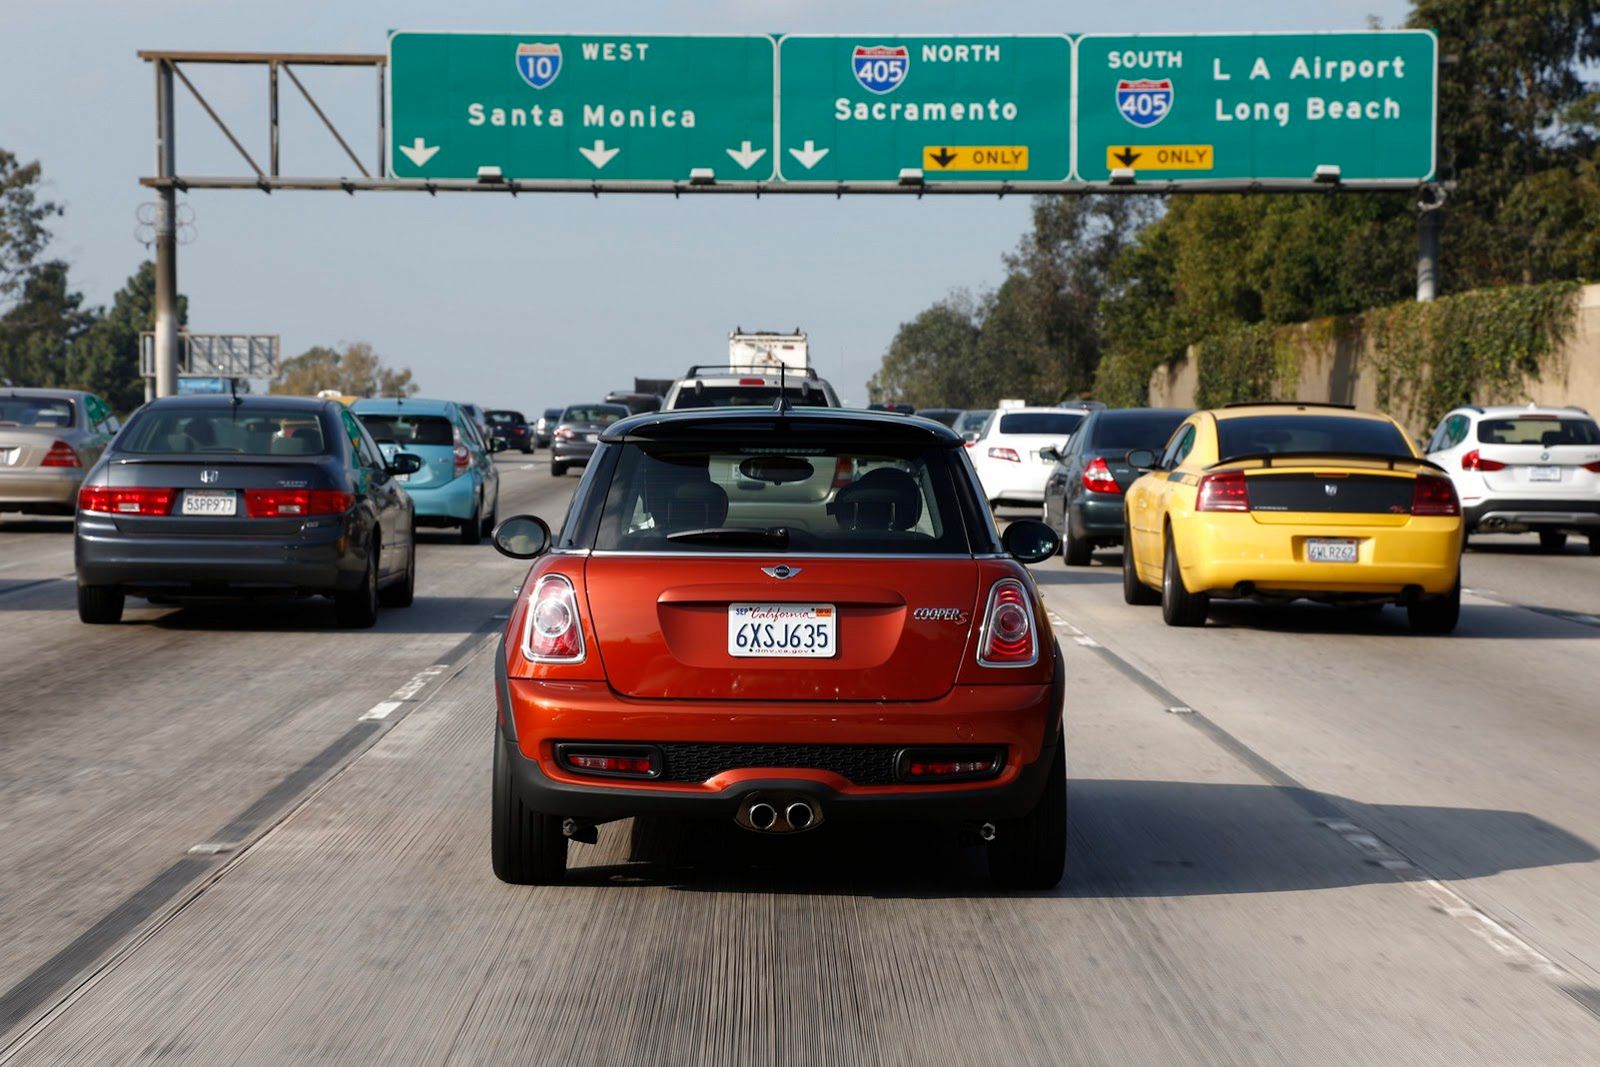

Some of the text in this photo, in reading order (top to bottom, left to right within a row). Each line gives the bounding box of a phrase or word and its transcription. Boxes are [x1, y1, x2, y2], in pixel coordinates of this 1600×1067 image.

[582, 43, 649, 61] WEST
[922, 44, 1000, 62] NORTH
[1108, 50, 1182, 69] SOUTH
[527, 57, 552, 79] 10
[858, 60, 903, 83] 405
[1213, 56, 1405, 82] L A Airport
[835, 98, 1018, 121] Sacramento
[1121, 93, 1168, 115] 405
[1215, 97, 1400, 127] Long Beach
[468, 103, 695, 128] Santa Monica
[973, 150, 1023, 165] ONLY
[1157, 149, 1208, 164] ONLY
[735, 607, 749, 616] SEP
[751, 606, 814, 622] California
[913, 607, 960, 621] COOPER
[736, 623, 829, 648] 6XSJ635
